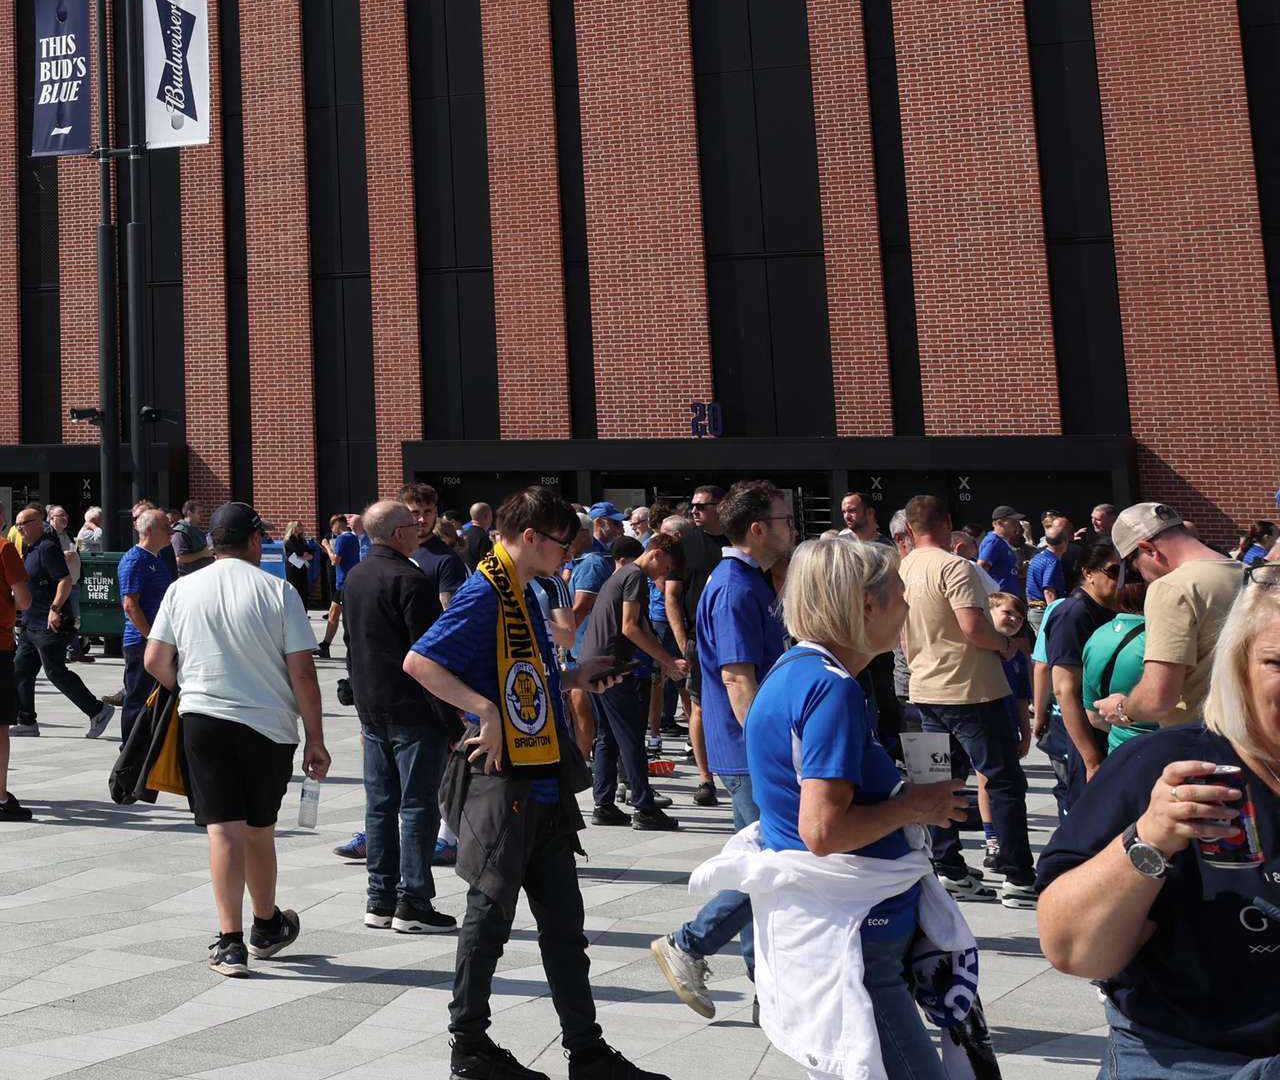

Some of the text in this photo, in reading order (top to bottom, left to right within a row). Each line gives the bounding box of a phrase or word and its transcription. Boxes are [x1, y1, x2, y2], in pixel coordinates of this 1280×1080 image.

[39, 34, 76, 58] THIS
[165, 4, 184, 113] Budweiser
[40, 57, 87, 82] BUD'S
[38, 80, 82, 105] BLUE
[691, 402, 722, 436] 20
[870, 476, 882, 490] X
[958, 476, 970, 490] X
[959, 492, 971, 502] 60
[87, 584, 110, 592] CUPS
[88, 592, 108, 600] HERE
[514, 735, 551, 749] BRIGHTON
